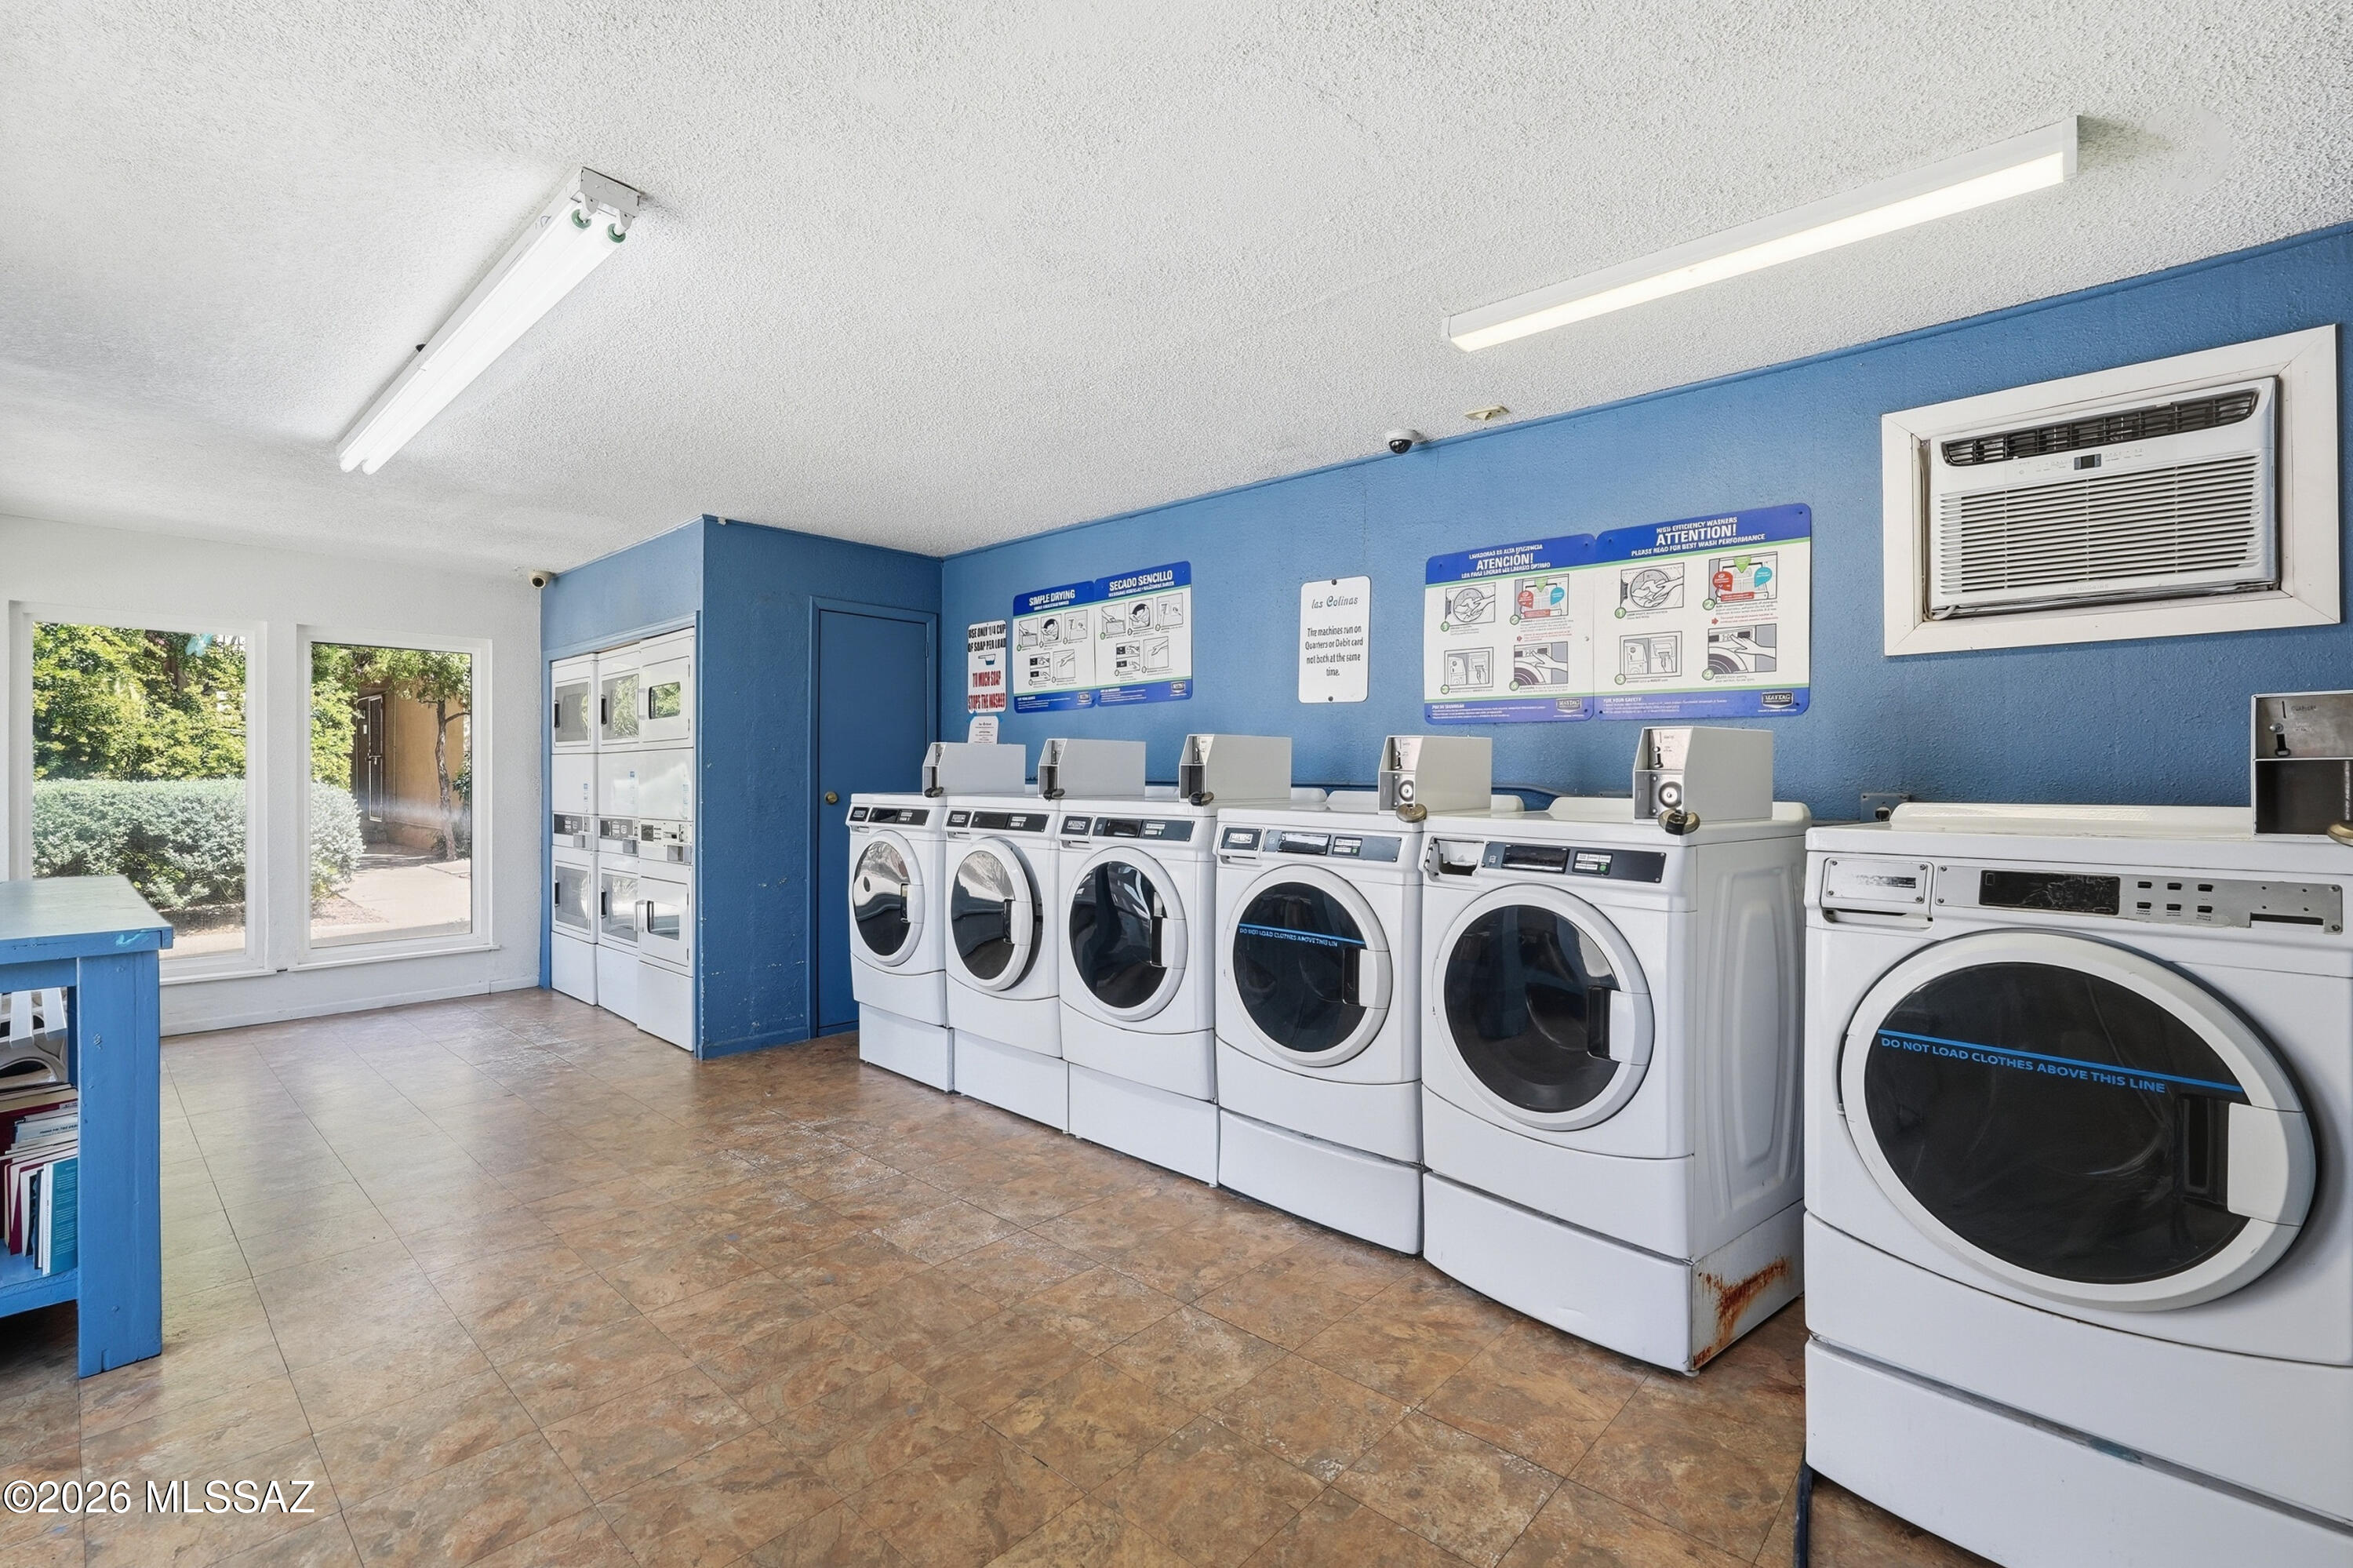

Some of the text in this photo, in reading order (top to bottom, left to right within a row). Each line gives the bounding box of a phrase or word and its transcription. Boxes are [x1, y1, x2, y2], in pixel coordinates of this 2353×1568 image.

[1707, 516, 1737, 526] WASHERS
[1656, 524, 1737, 546] ATTENTION!
[1682, 541, 1697, 551] BEST
[1698, 539, 1718, 548] WASH
[1718, 533, 1766, 546] PERFORMANCE
[1476, 552, 1534, 571] ATENCIÓN!
[1109, 577, 1137, 591] SECADO
[1137, 569, 1173, 587] SENCILLO
[1029, 595, 1050, 606] SIMPLE
[1051, 589, 1075, 602] DRYING
[1326, 595, 1358, 607] Colinas
[977, 627, 987, 637] ONLY
[1307, 628, 1317, 637] The
[1318, 625, 1343, 636] machines
[973, 641, 985, 652] SOAP
[986, 640, 995, 649] PER
[995, 638, 1006, 649] LOAD
[1305, 641, 1328, 650] Quarters
[1335, 638, 1350, 647] Debit
[1351, 637, 1363, 646] card
[1307, 655, 1315, 664] not
[1316, 653, 1329, 664] both
[1329, 653, 1336, 663] at
[1336, 652, 1346, 662] the
[991, 671, 1001, 686] SOAP
[1326, 666, 1340, 677] time.
[1882, 1038, 2166, 1093] DO NOT LOAD CLOTHES ABOVE THIS LINE
